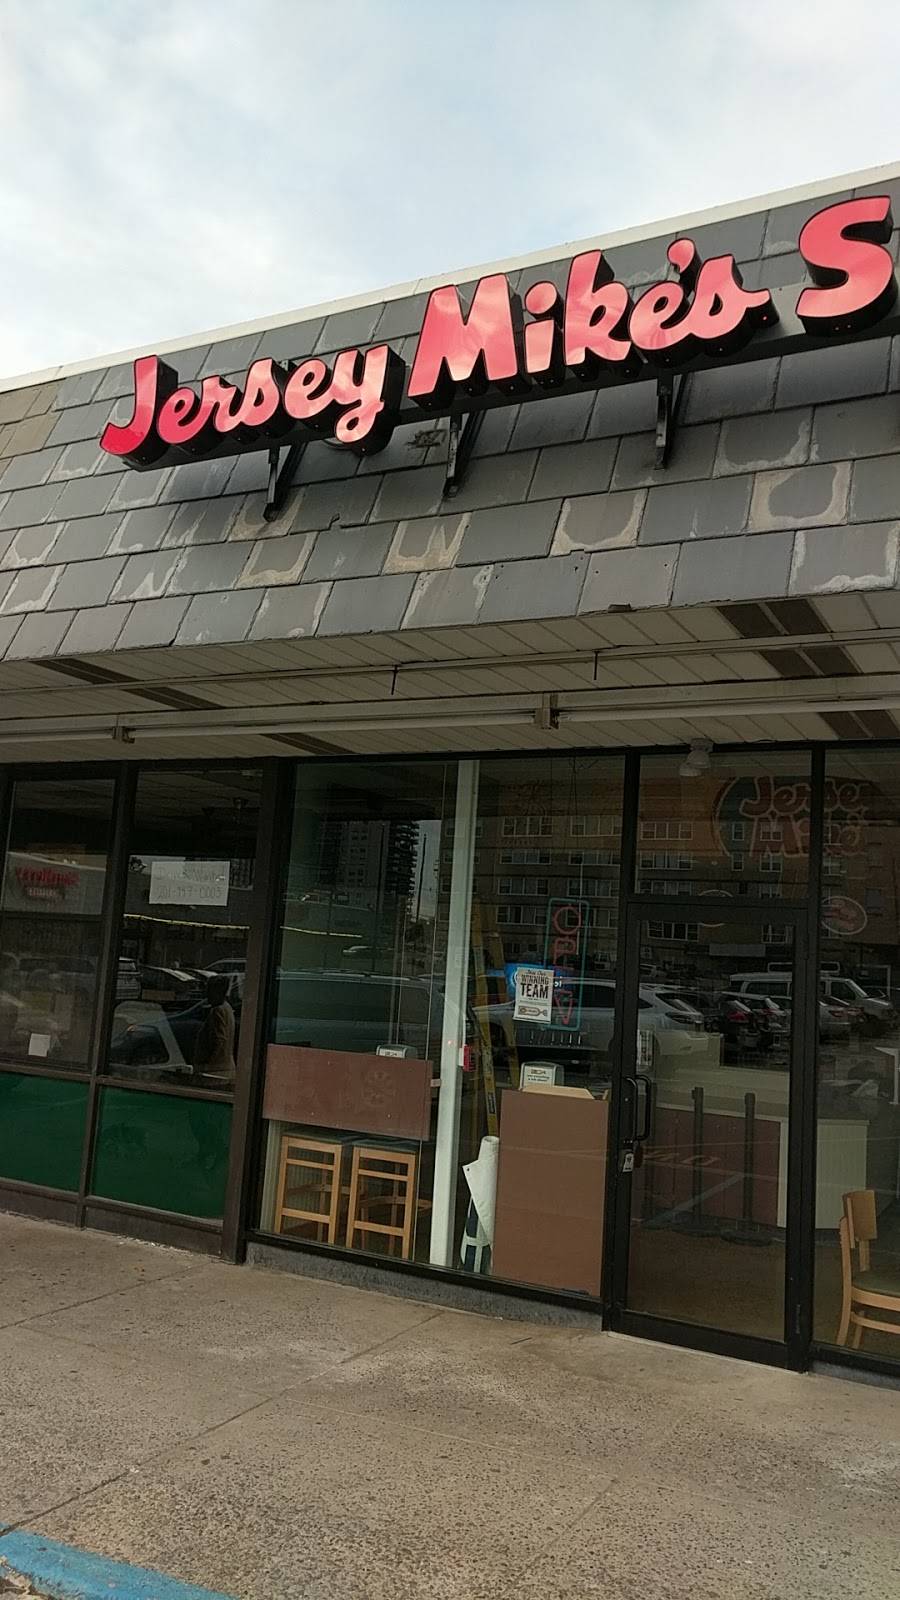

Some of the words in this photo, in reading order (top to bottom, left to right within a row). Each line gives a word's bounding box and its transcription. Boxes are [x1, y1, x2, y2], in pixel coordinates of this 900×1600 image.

[100, 344, 390, 456] Jersey
[407, 238, 771, 397] Mike's
[520, 973, 550, 985] WINNING
[520, 982, 550, 999] TEAM
